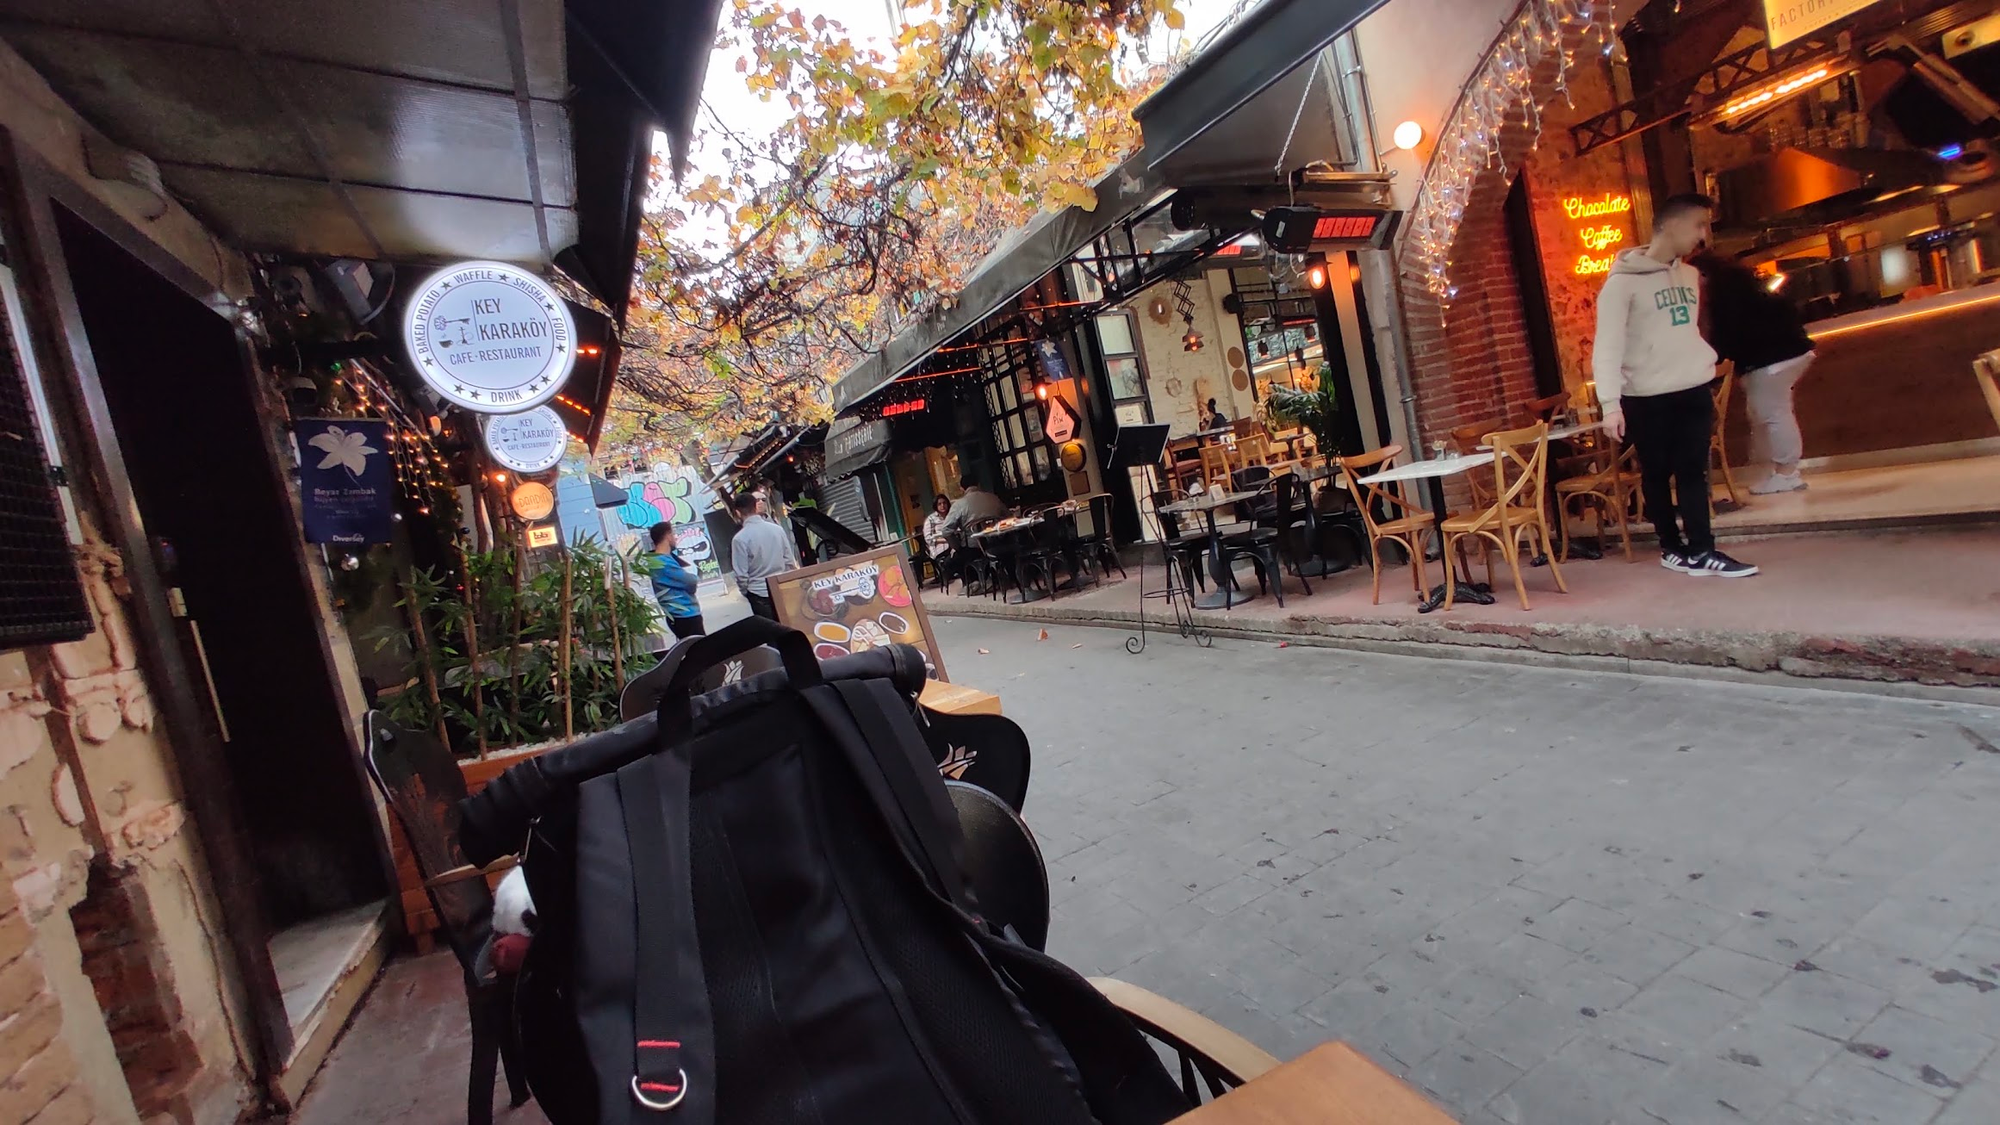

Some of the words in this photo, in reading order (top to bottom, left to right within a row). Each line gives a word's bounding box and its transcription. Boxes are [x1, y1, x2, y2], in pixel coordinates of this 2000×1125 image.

[1770, 0, 1835, 31] FACTOR
[1563, 193, 1631, 219] Chocolate
[1580, 225, 1623, 250] Coffee
[453, 270, 494, 284] WAFFLE
[513, 277, 546, 302] SHISHA
[416, 289, 440, 321] POTATO
[475, 298, 502, 315] KEY
[1669, 305, 1691, 326] 13
[415, 323, 429, 354] BAKED
[479, 318, 548, 341] KARAKÖY
[552, 317, 566, 341] FOOD
[491, 389, 523, 403] DRINK
[519, 418, 533, 427] KEY
[813, 578, 832, 589] KEY
[834, 566, 878, 583] KARAKÖY
